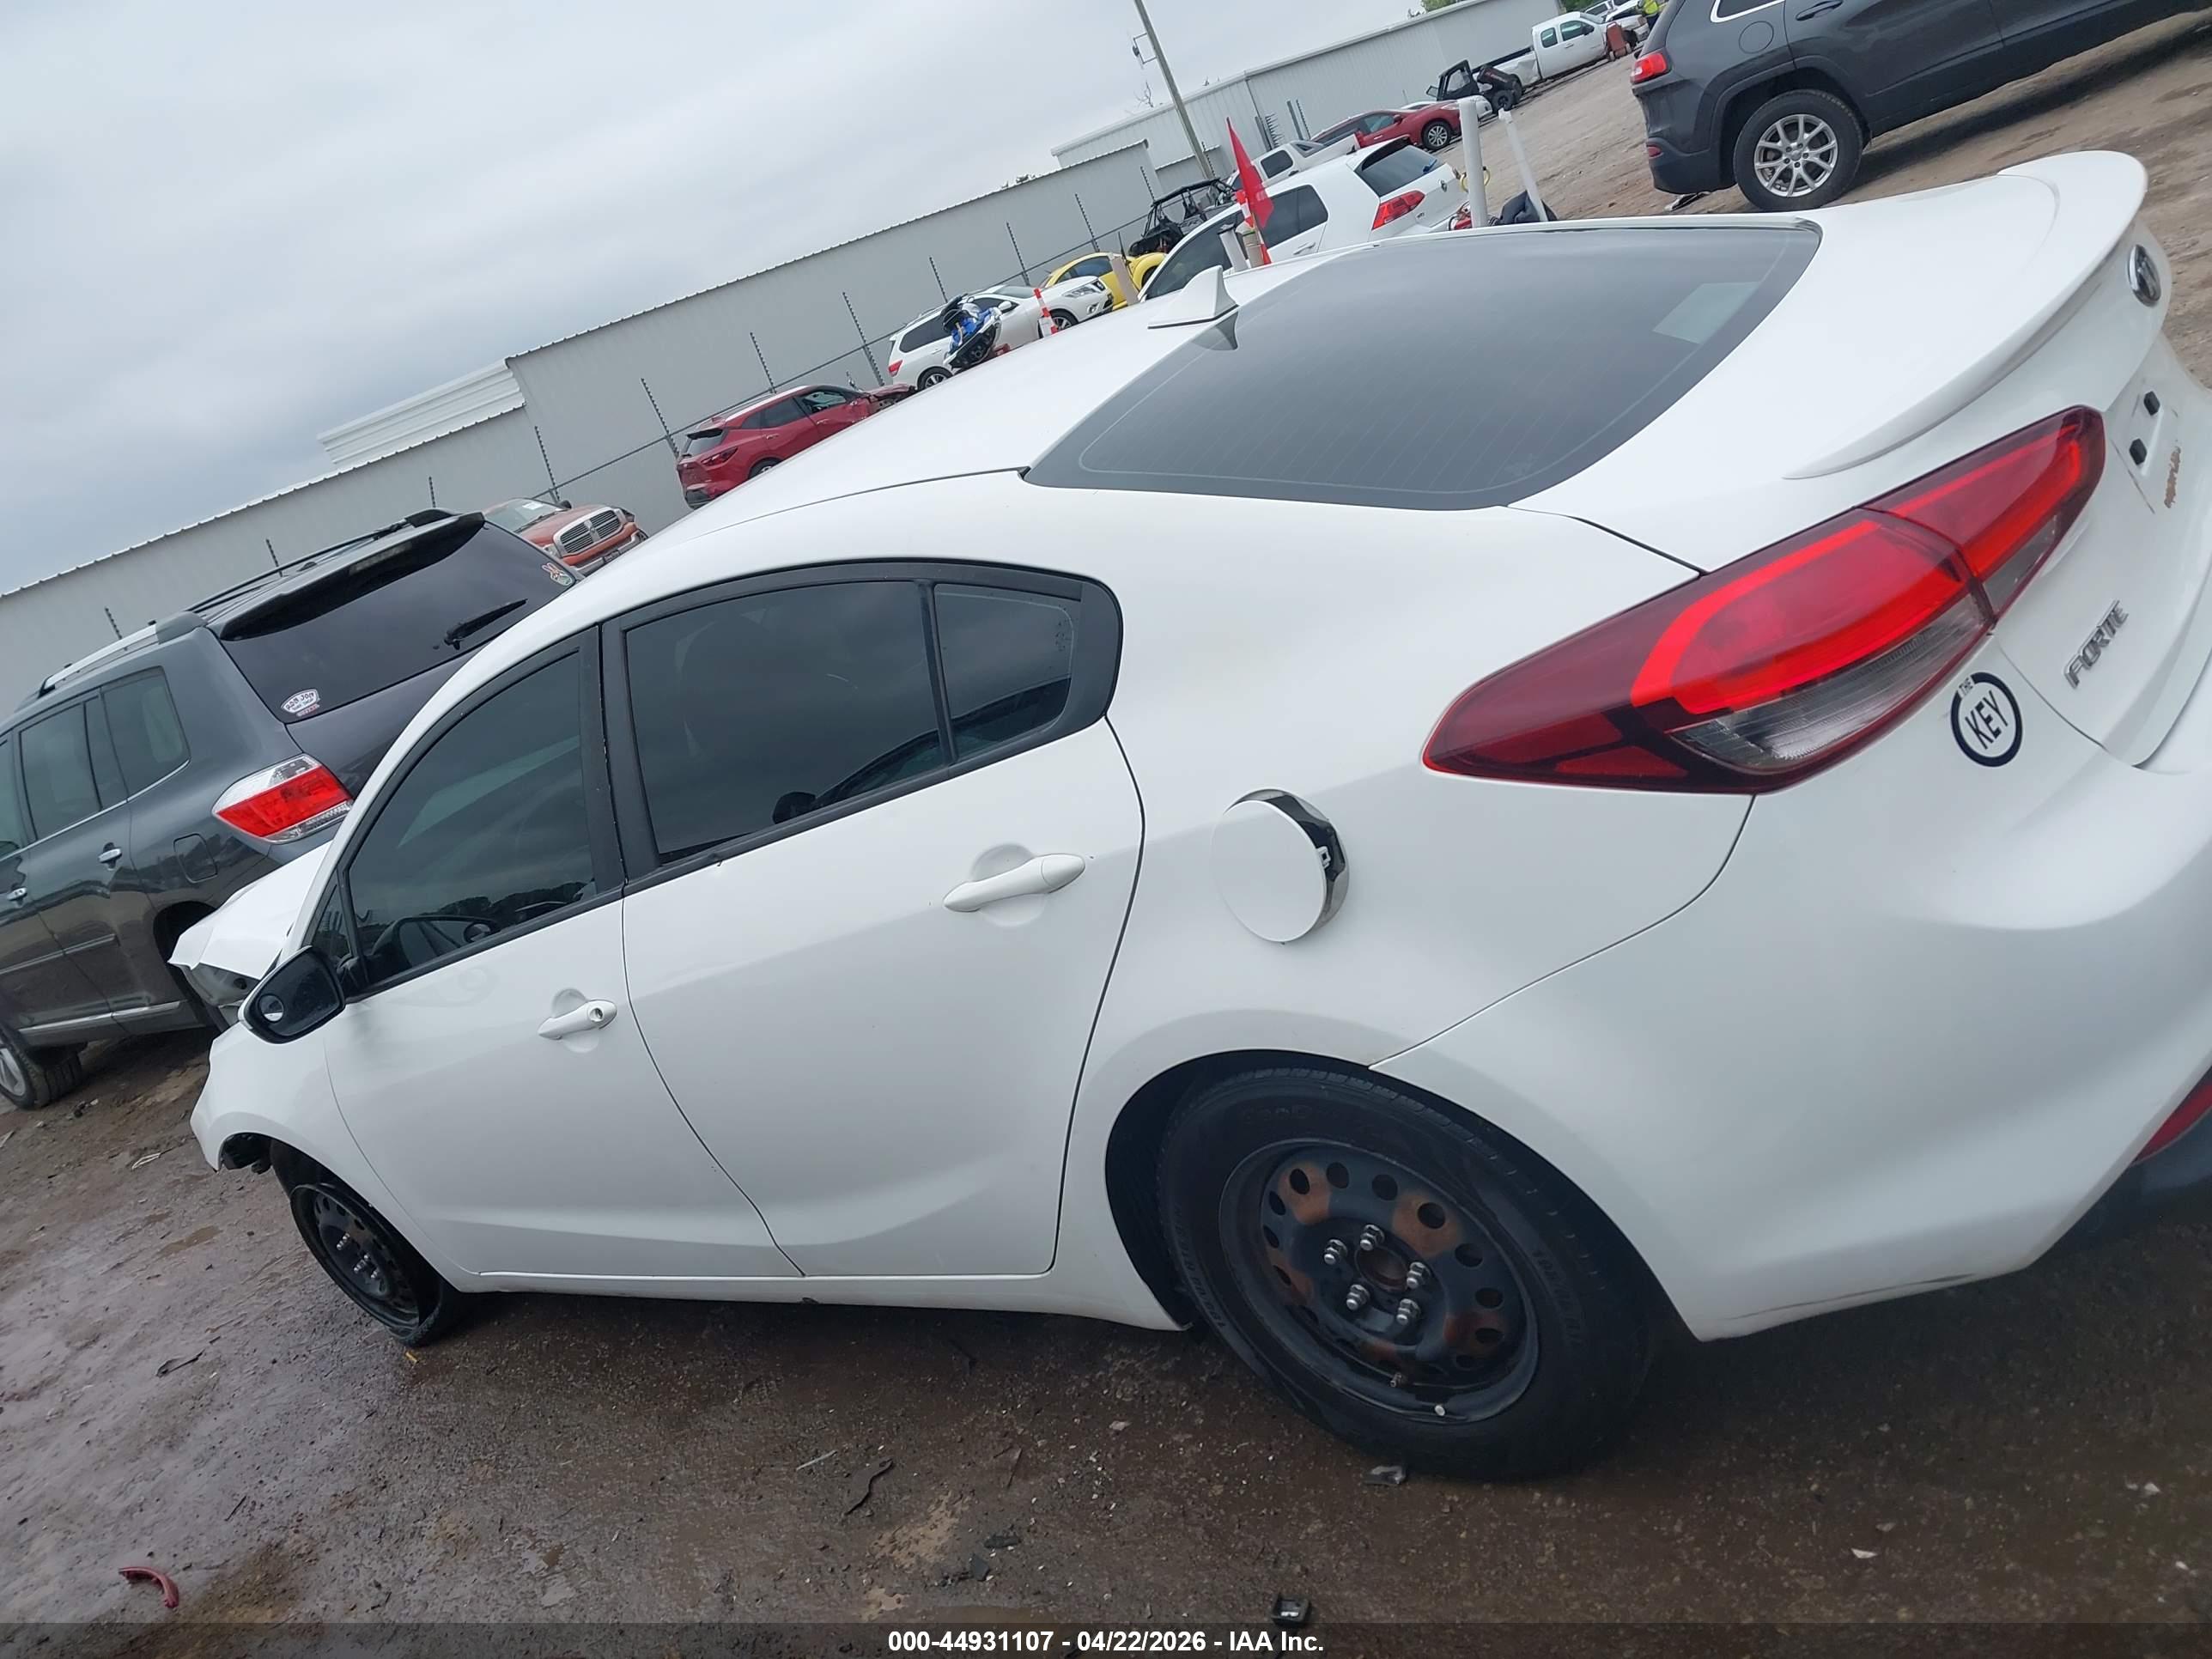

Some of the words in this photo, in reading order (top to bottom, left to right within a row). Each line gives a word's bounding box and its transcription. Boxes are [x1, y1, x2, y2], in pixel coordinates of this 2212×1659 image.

[2063, 599, 2130, 689] FORTE
[1959, 677, 1973, 696] THE
[1965, 690, 2008, 750] KEY
